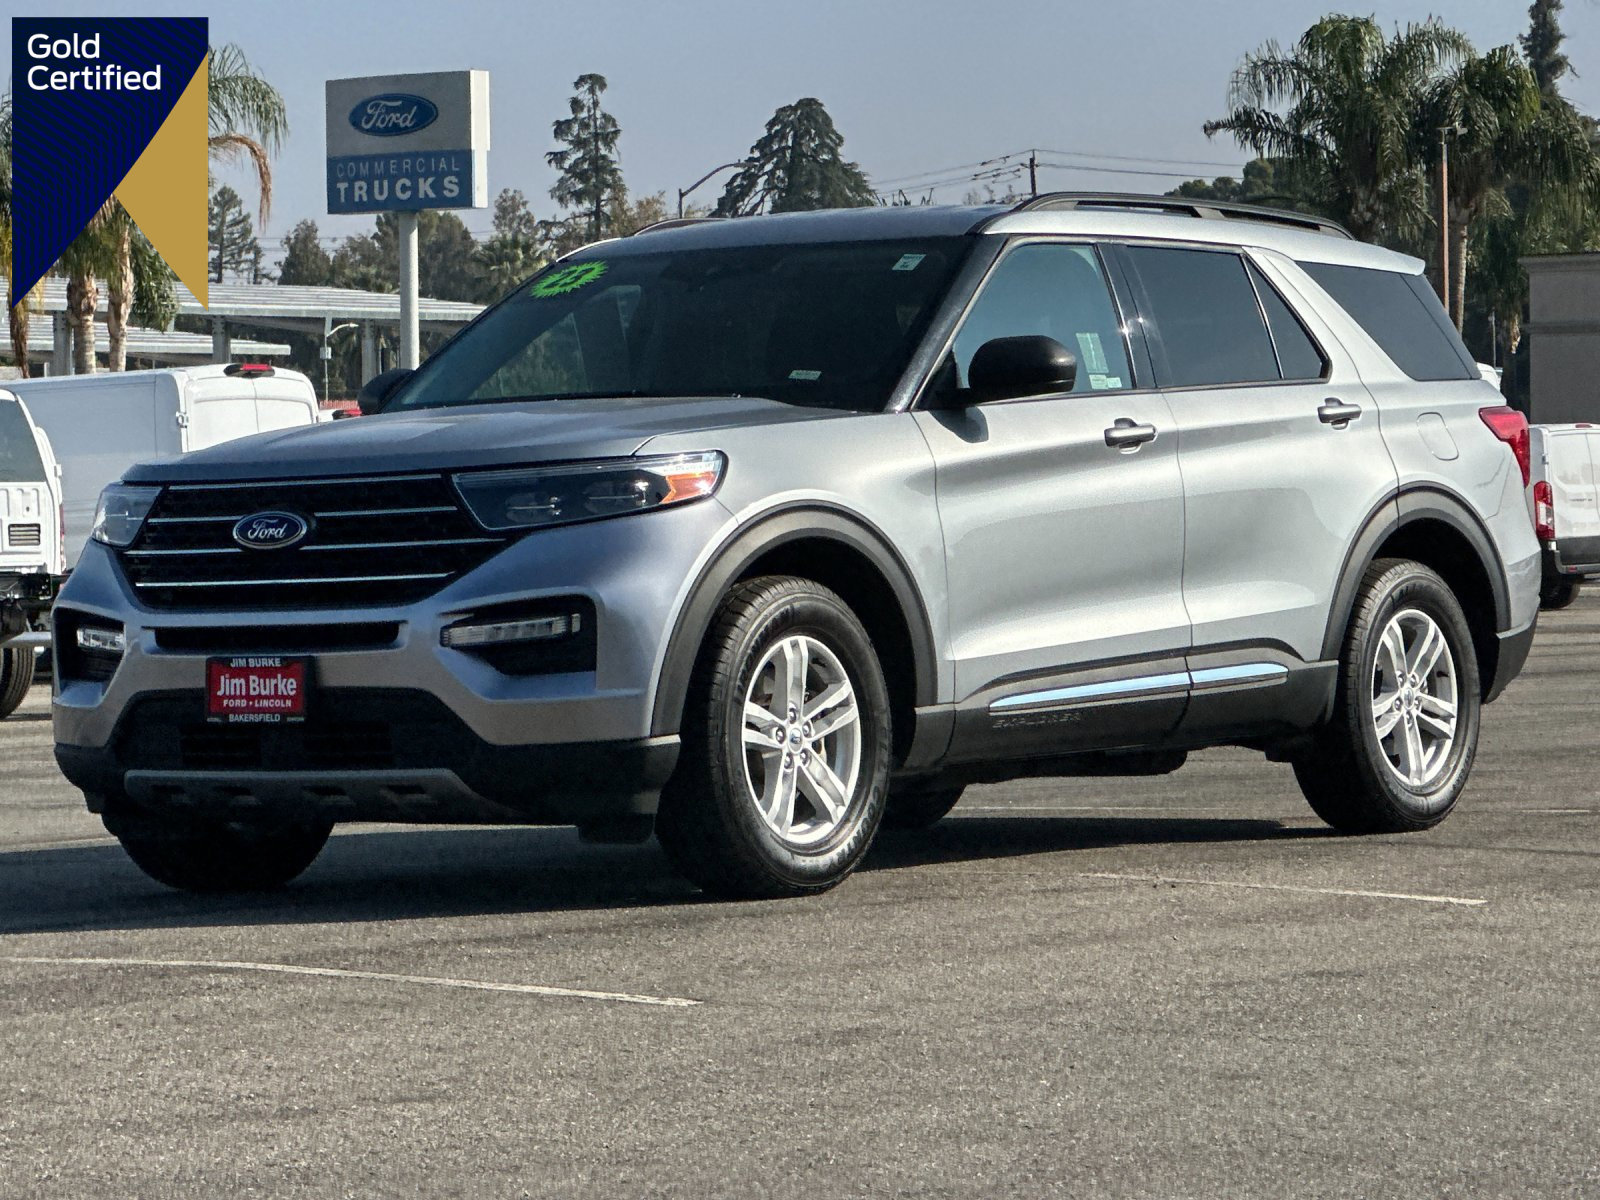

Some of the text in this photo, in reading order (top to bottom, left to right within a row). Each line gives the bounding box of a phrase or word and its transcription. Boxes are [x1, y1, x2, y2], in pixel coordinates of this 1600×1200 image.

[361, 100, 418, 129] Ford
[336, 157, 460, 178] COMMERCIAL
[336, 175, 460, 203] TRUCKS
[247, 518, 287, 538] Ford
[230, 658, 282, 667] JIM BURKE
[217, 674, 297, 696] Jim Burke
[223, 699, 291, 708] FORD LINCOLN
[229, 713, 281, 722] BAKERSFIELD
